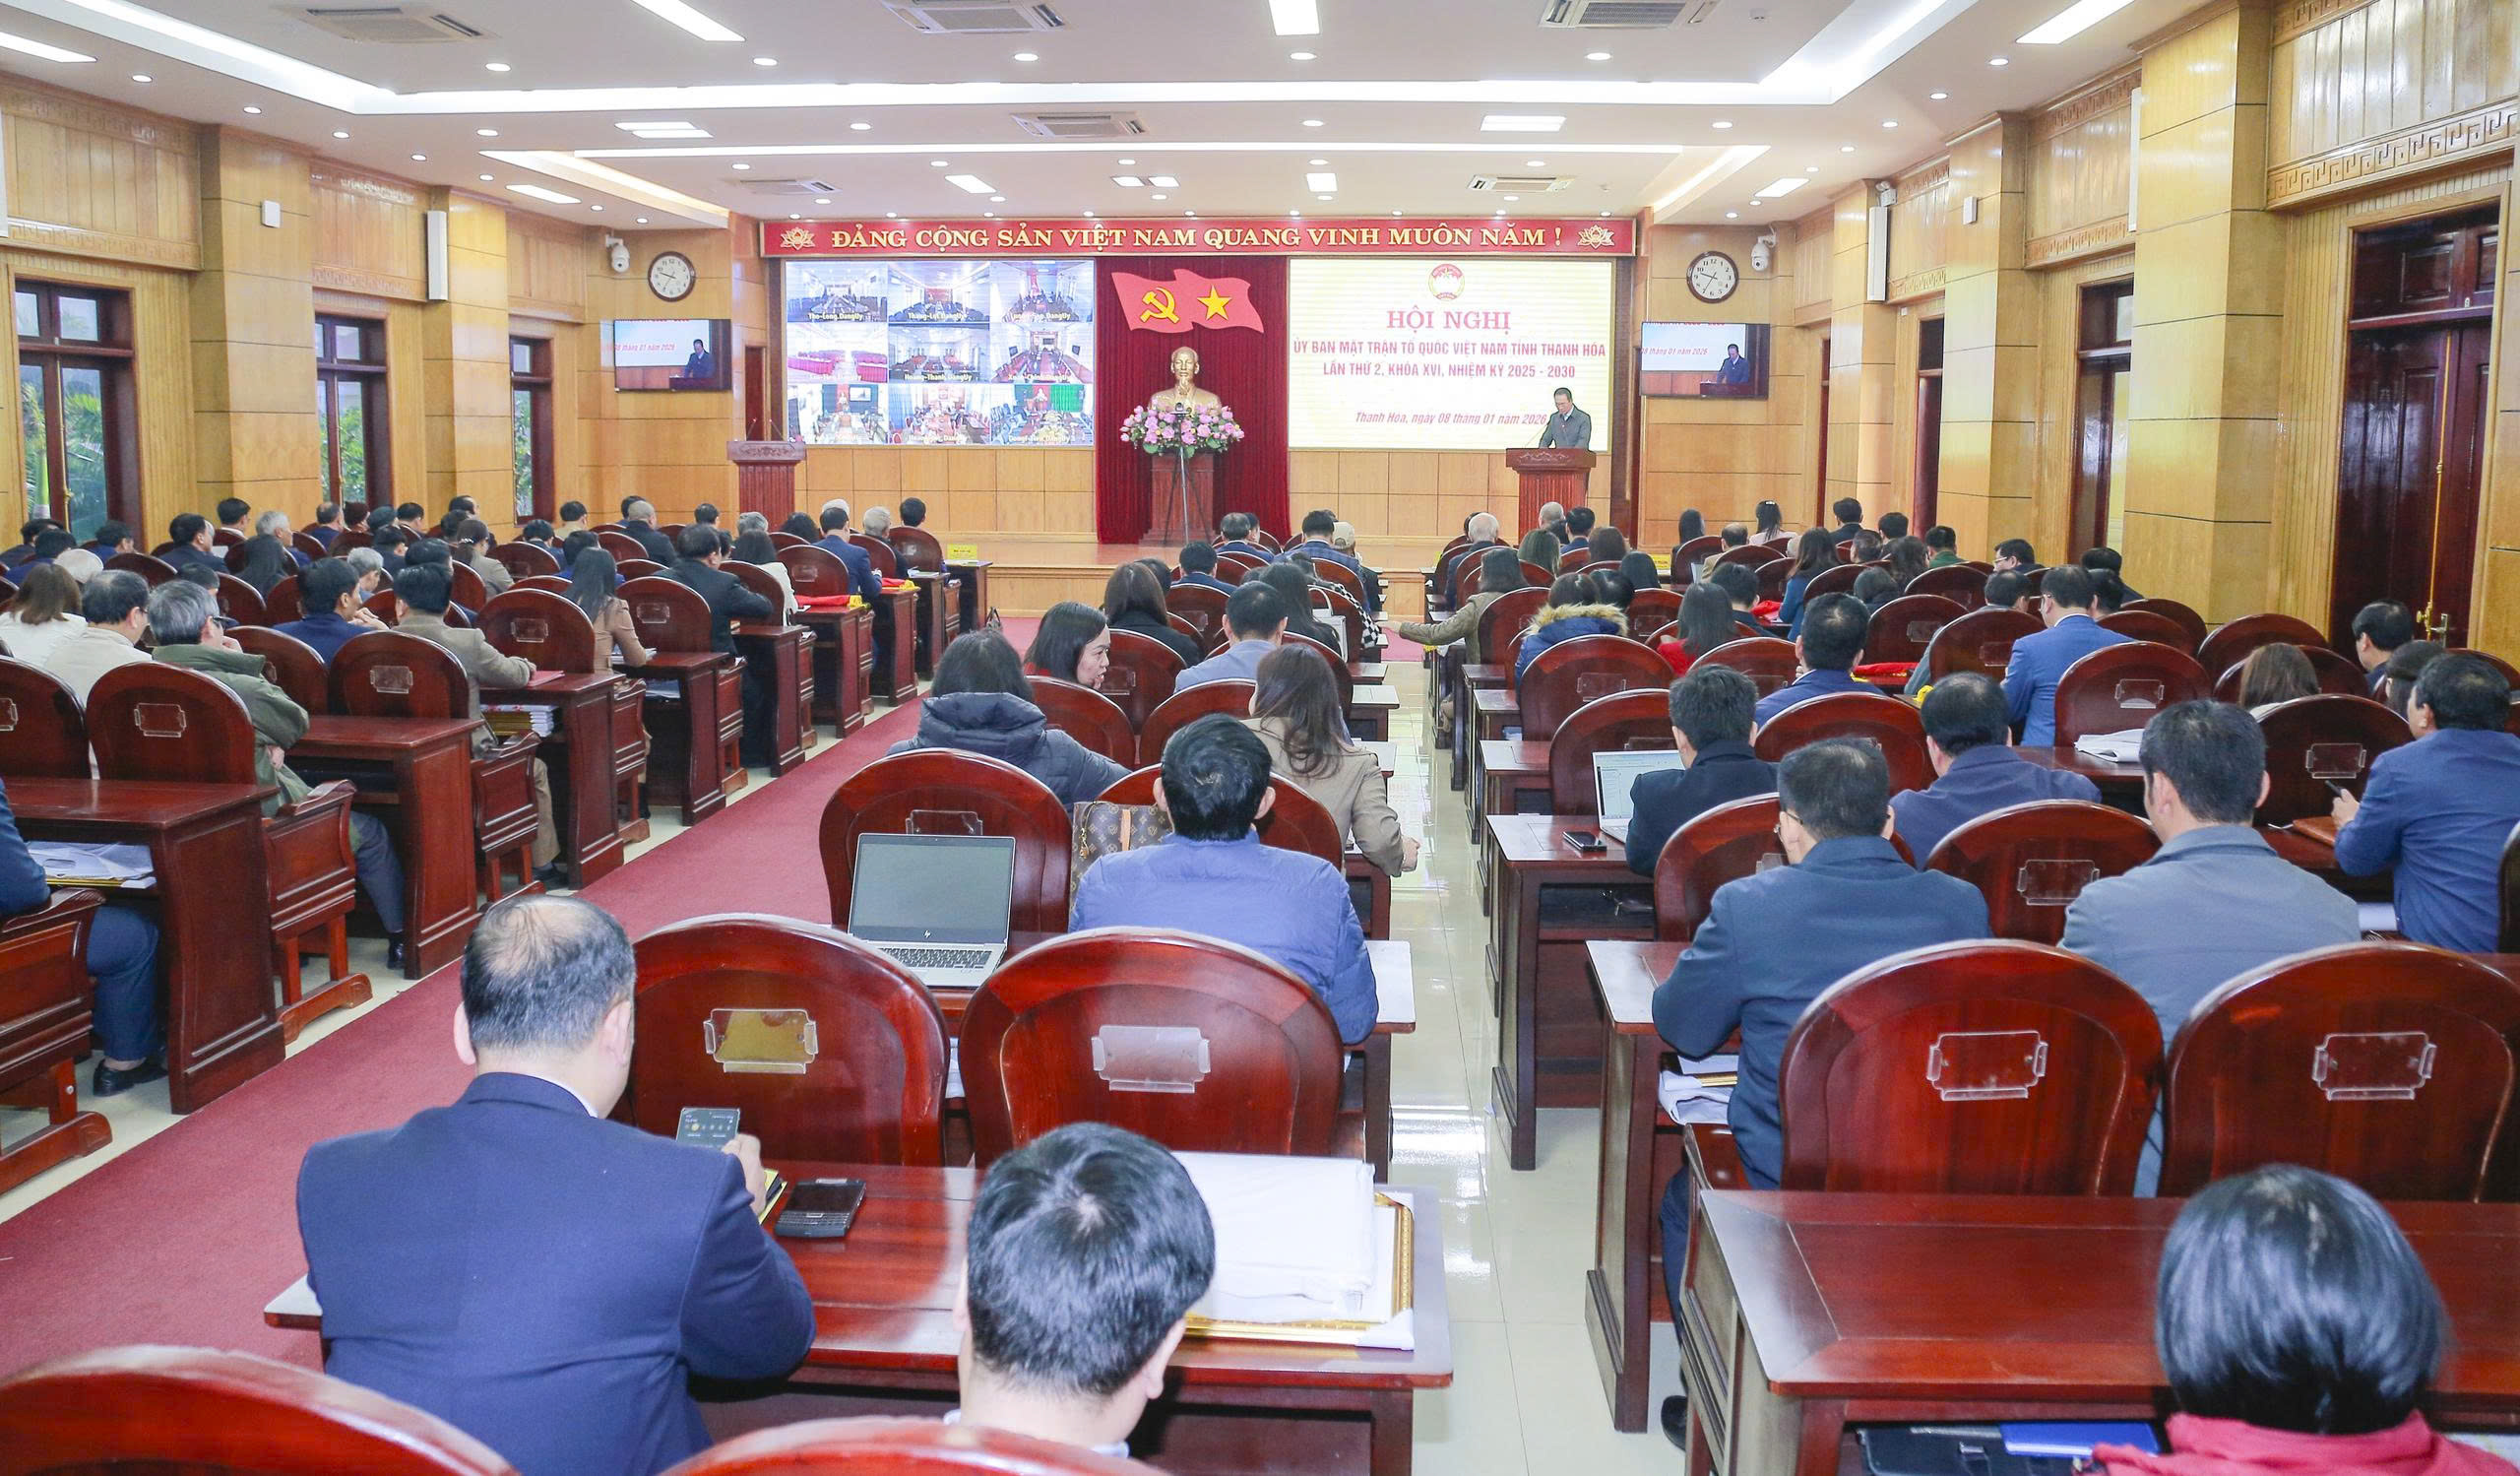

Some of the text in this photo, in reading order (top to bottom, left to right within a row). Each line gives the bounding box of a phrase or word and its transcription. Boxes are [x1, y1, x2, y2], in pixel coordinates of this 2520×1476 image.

[831, 222, 1562, 253] ĐẢNG CỘNG SẢN VIỆT NAM QUANG VINH MUÔN NĂM !
[1386, 304, 1511, 336] HỘI NGHỊ
[1293, 336, 1308, 353] ỦY
[1311, 341, 1336, 354] BAN
[1339, 340, 1364, 357] MẶT
[1367, 340, 1398, 357] TRẬN
[1418, 338, 1450, 356] QUỐC
[1453, 339, 1477, 358] VIỆT
[1480, 342, 1508, 355] NAM
[1511, 339, 1538, 356] TỈNH
[1541, 343, 1579, 356] THANH
[1582, 341, 1606, 357] HÓA
[1323, 357, 1346, 376] LẦN
[1350, 359, 1372, 376] THỨ
[1374, 363, 1385, 377] 2,
[1388, 359, 1419, 377] KHÓA
[1422, 363, 1445, 378] XVI,
[1448, 360, 1486, 379] NHIỆM
[1489, 360, 1504, 378] KỲ
[1507, 364, 1536, 378] 2025
[1547, 364, 1576, 378] 2030
[1355, 412, 1385, 423] Thanh
[1438, 413, 1451, 423] 08
[1482, 413, 1495, 424] 01
[1522, 414, 1548, 425] 2026
